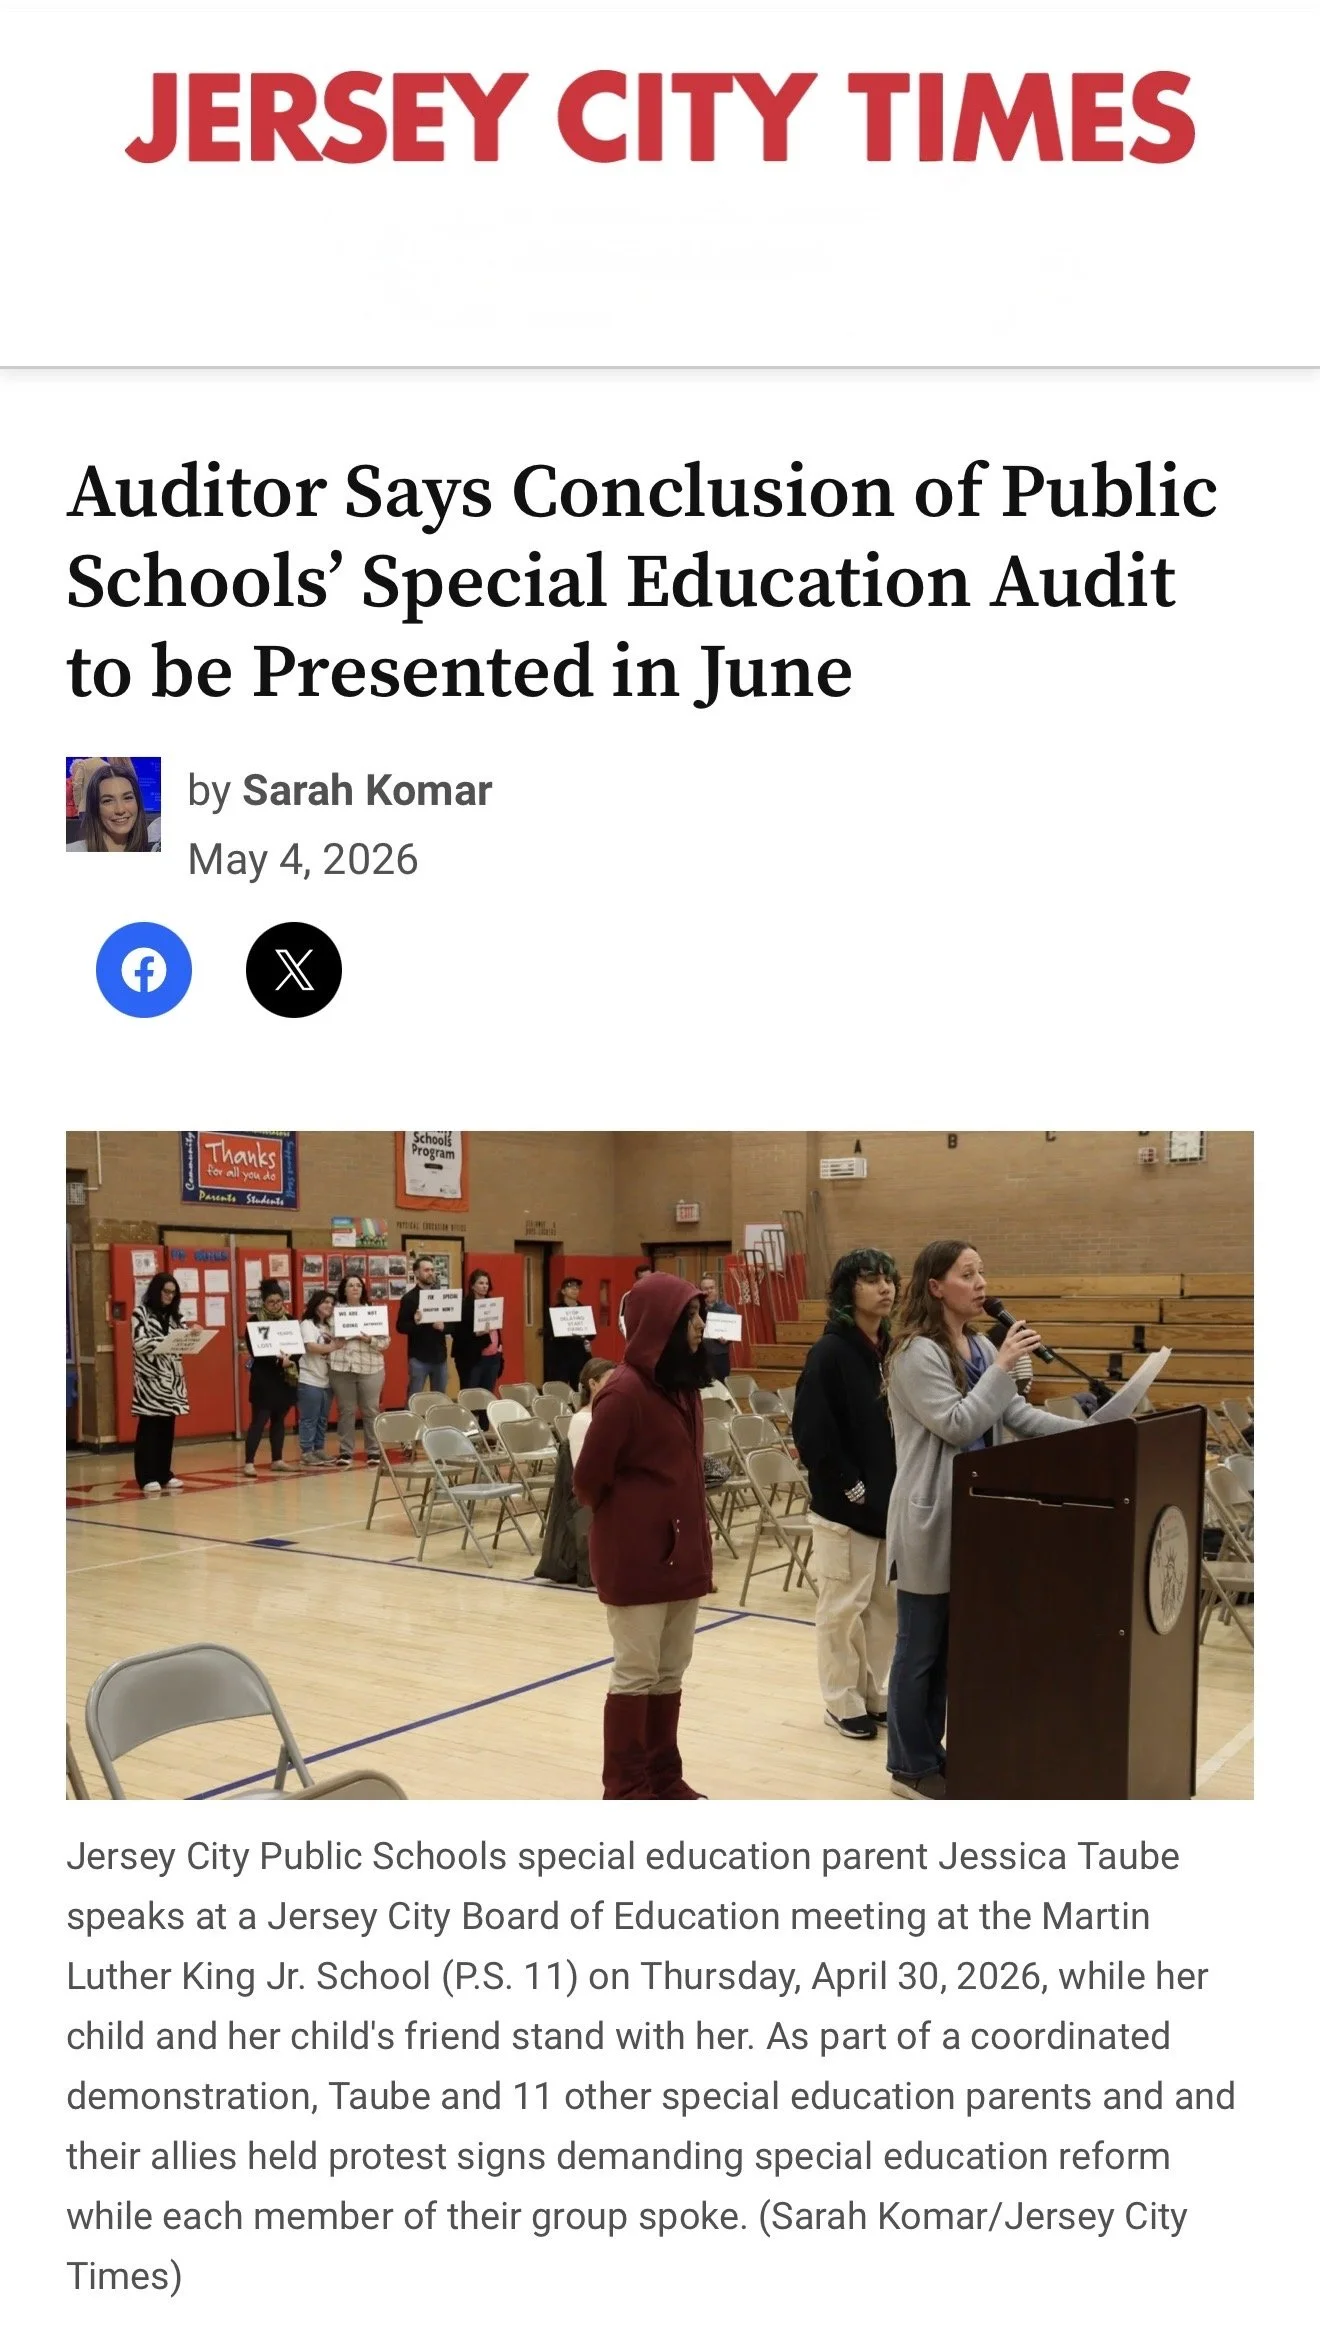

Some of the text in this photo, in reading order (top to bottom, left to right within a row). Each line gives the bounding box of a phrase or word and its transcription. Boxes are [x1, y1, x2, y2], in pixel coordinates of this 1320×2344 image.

[413, 1131, 452, 1147] Schools
[854, 1139, 862, 1154] A
[948, 1133, 958, 1149] B
[205, 1139, 276, 1170] Thanks
[412, 1143, 455, 1160] Program
[185, 1132, 195, 1191] Community
[207, 1164, 276, 1182] for all you do
[199, 1190, 284, 1206] Parents Students
[257, 1325, 270, 1340] 7
